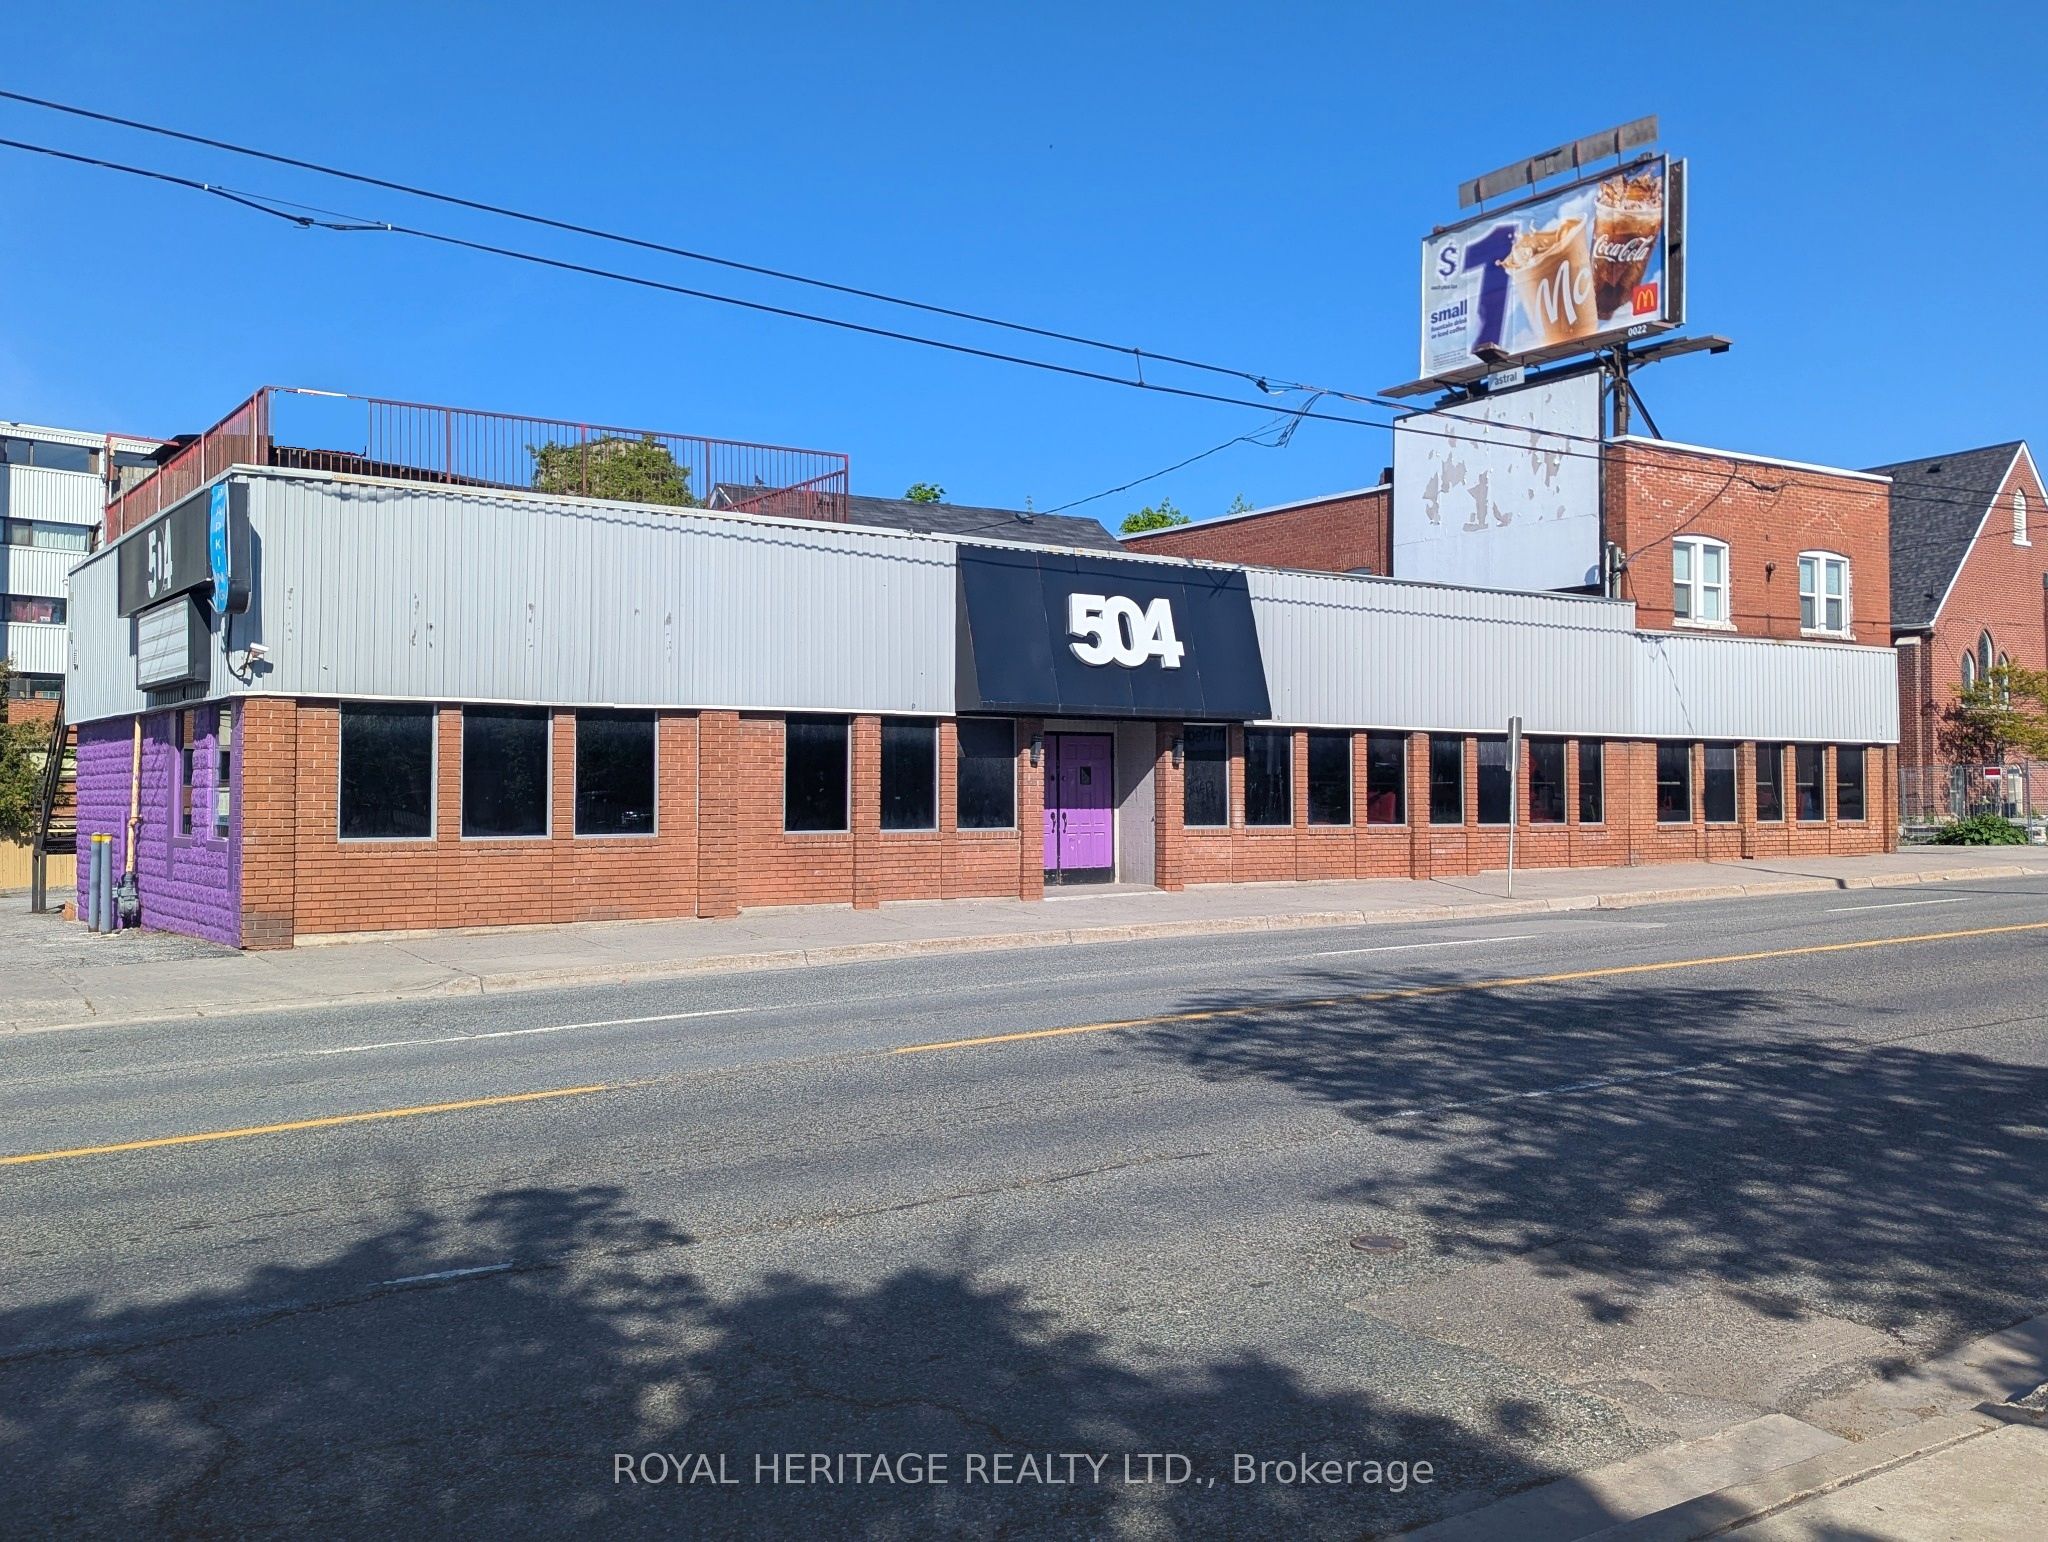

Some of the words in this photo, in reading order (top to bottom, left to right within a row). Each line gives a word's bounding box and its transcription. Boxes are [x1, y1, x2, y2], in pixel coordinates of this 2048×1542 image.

[1431, 299, 1467, 324] small
[1627, 324, 1648, 338] 0022
[1494, 371, 1518, 386] astral
[1066, 592, 1185, 669] 504
